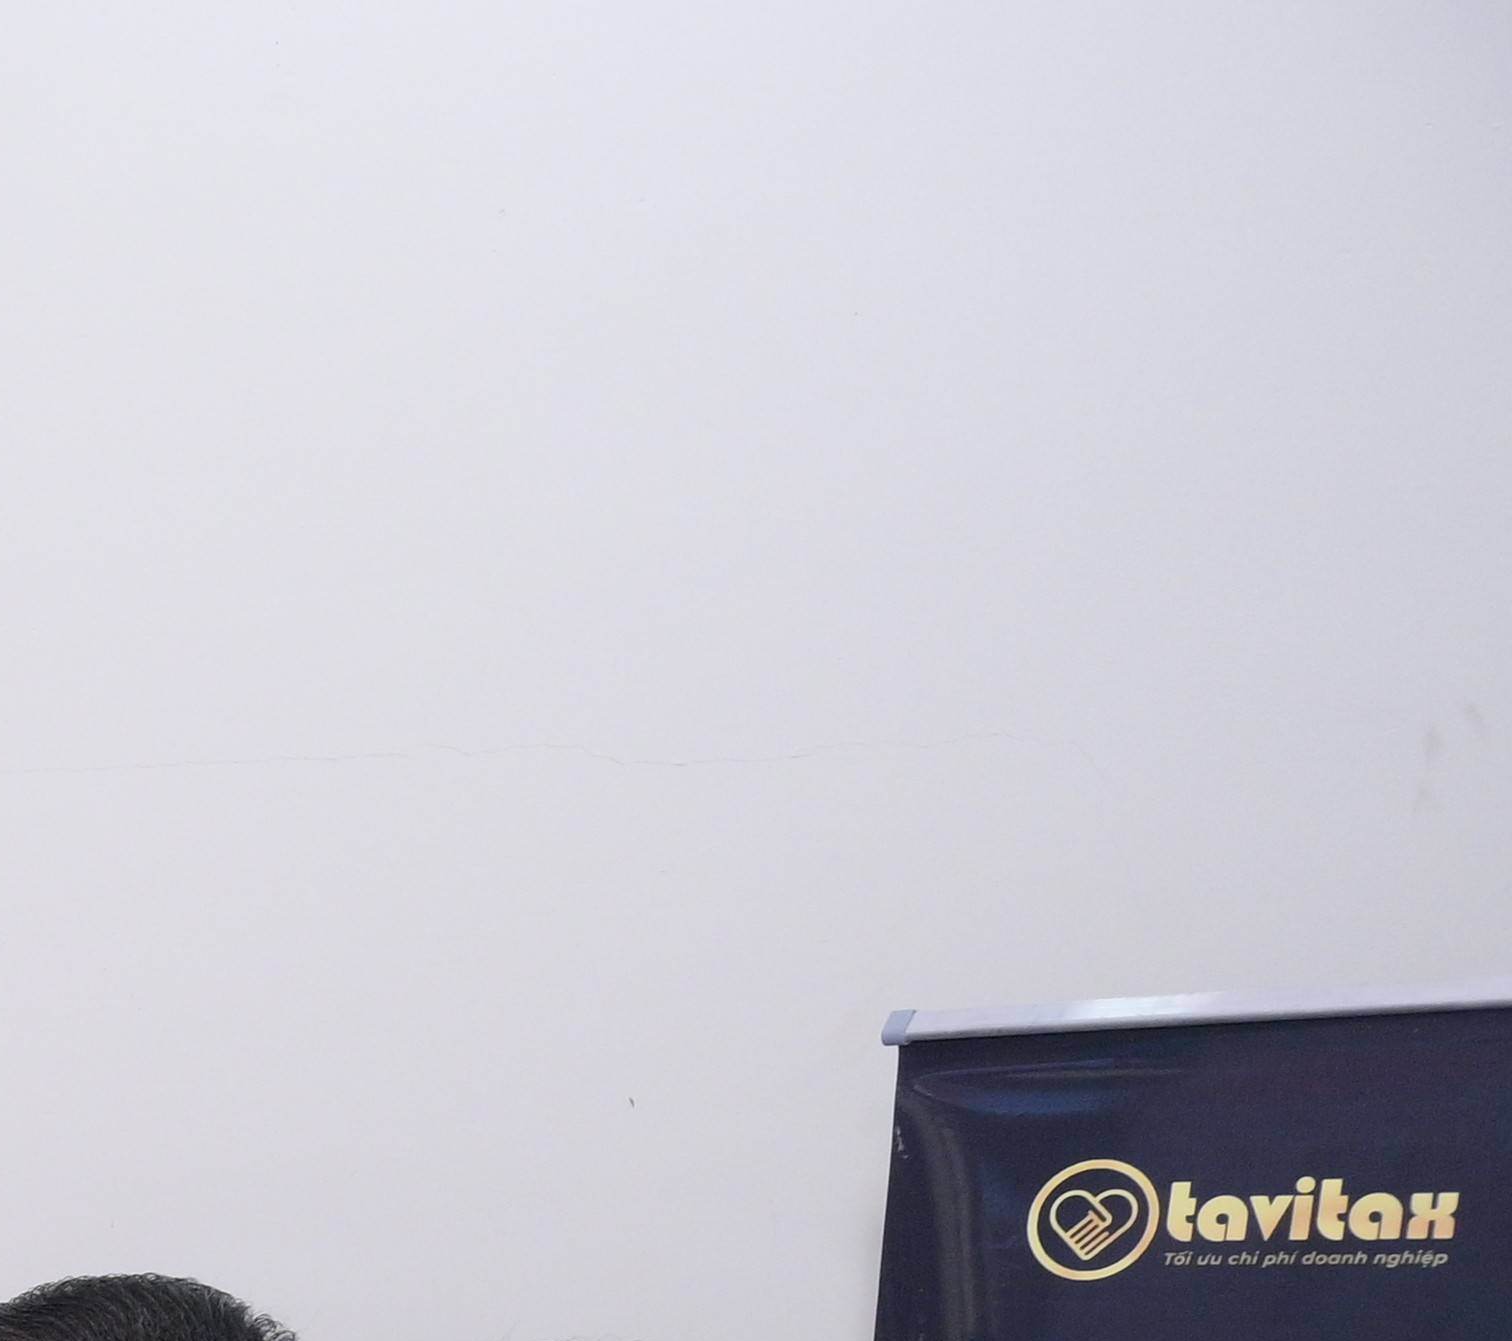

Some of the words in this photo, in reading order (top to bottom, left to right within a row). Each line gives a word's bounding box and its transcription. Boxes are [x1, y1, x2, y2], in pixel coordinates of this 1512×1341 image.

[1165, 1175, 1460, 1242] tavitax
[1164, 1250, 1193, 1267] Tối
[1227, 1250, 1259, 1267] chi
[1262, 1250, 1297, 1270] phí
[1301, 1250, 1368, 1266] doanh
[1372, 1250, 1449, 1270] nghiệp
